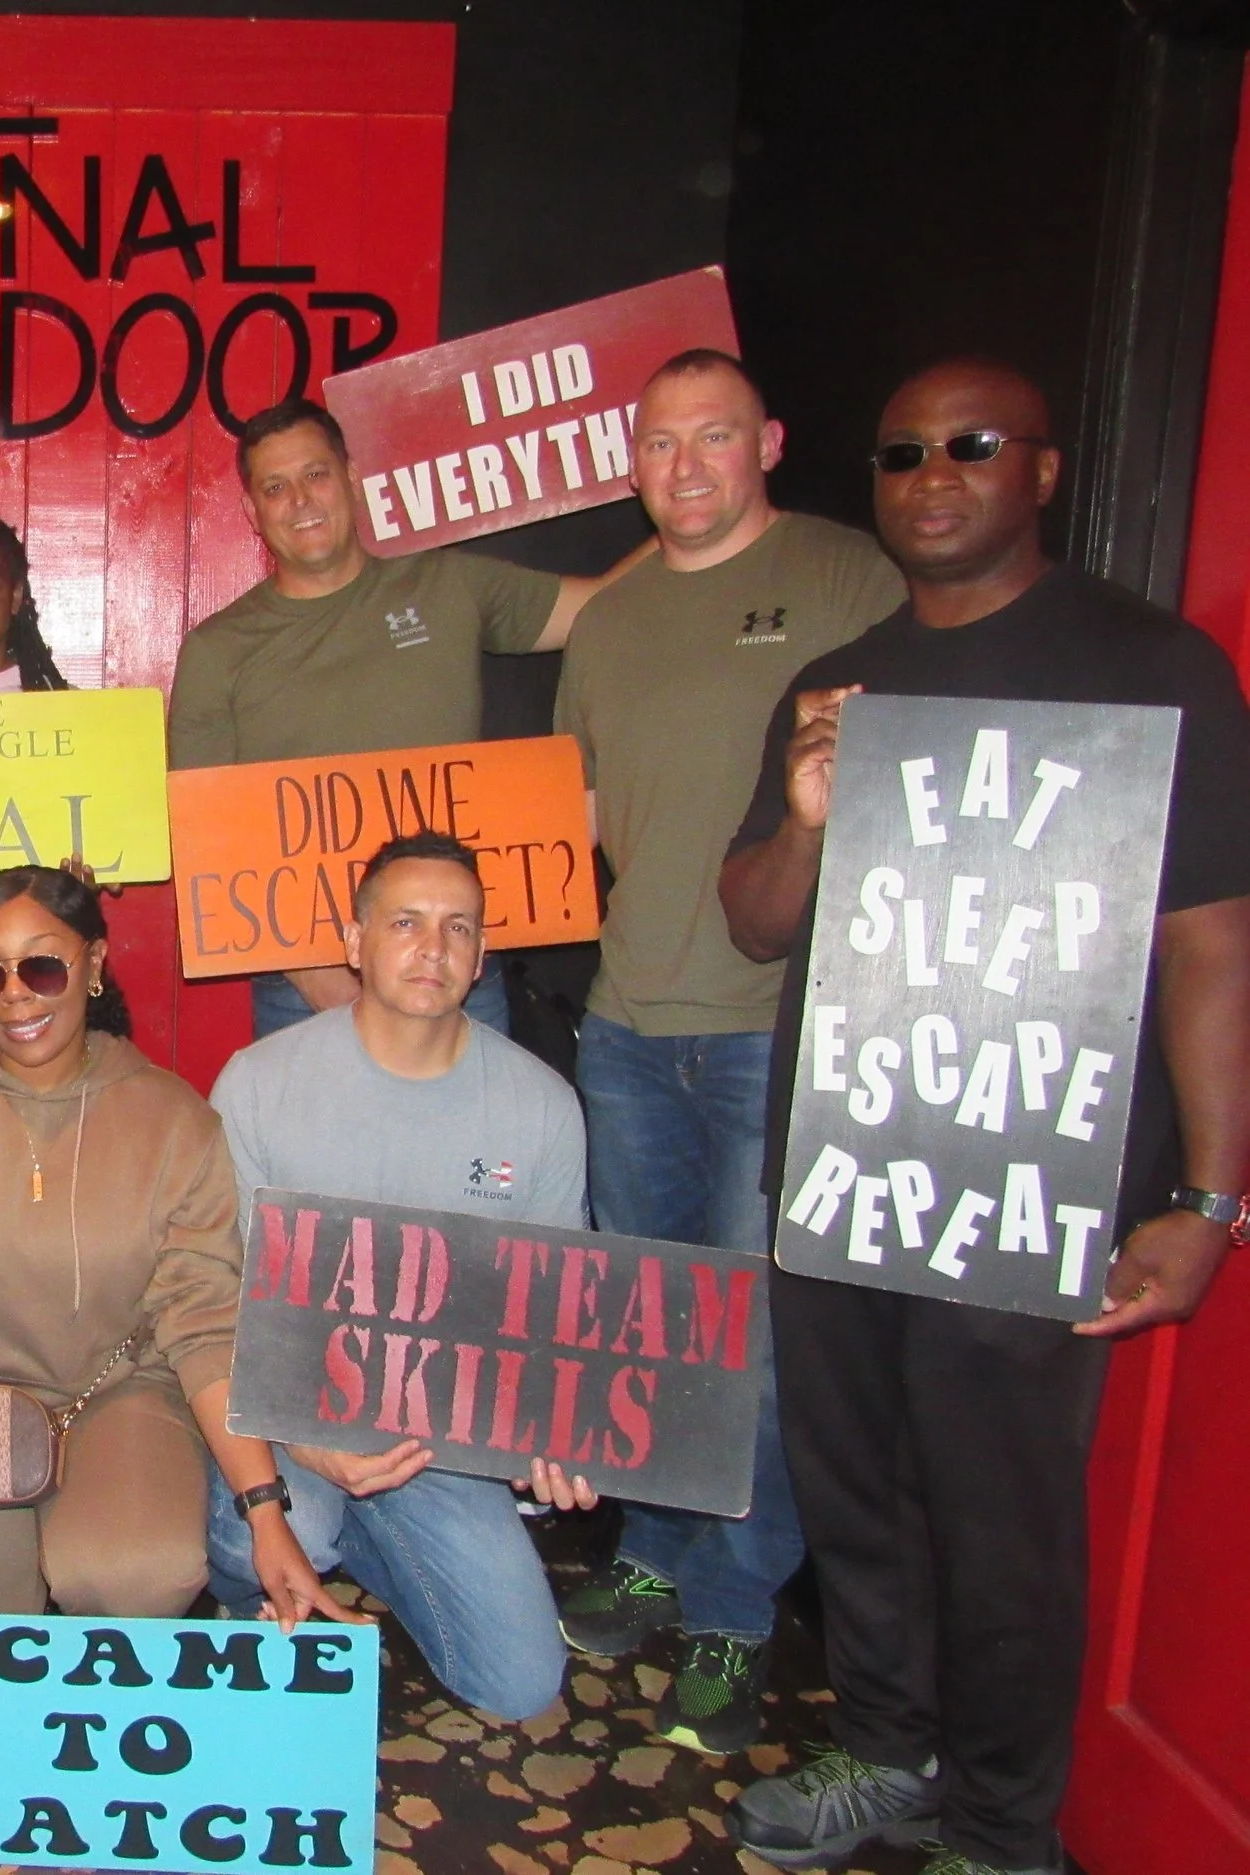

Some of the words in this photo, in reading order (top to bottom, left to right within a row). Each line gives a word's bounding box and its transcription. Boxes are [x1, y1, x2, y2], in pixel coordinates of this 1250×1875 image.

[461, 371, 487, 427] I
[493, 343, 595, 418] DID
[361, 402, 638, 542] EVERYTH
[735, 634, 786, 646] FREEDOM
[275, 771, 364, 859] DID
[376, 760, 481, 842] WE
[900, 728, 1082, 851] EAT
[849, 866, 1101, 997] SLEEP
[813, 1005, 1114, 1142] ESCAPE
[463, 1187, 512, 1201] FREEDOM
[785, 1143, 1103, 1298] REPEAT
[249, 1203, 450, 1324] MAD
[494, 1235, 759, 1372] TEAM
[317, 1323, 658, 1471] SKILLS
[43, 1711, 193, 1776] TO
